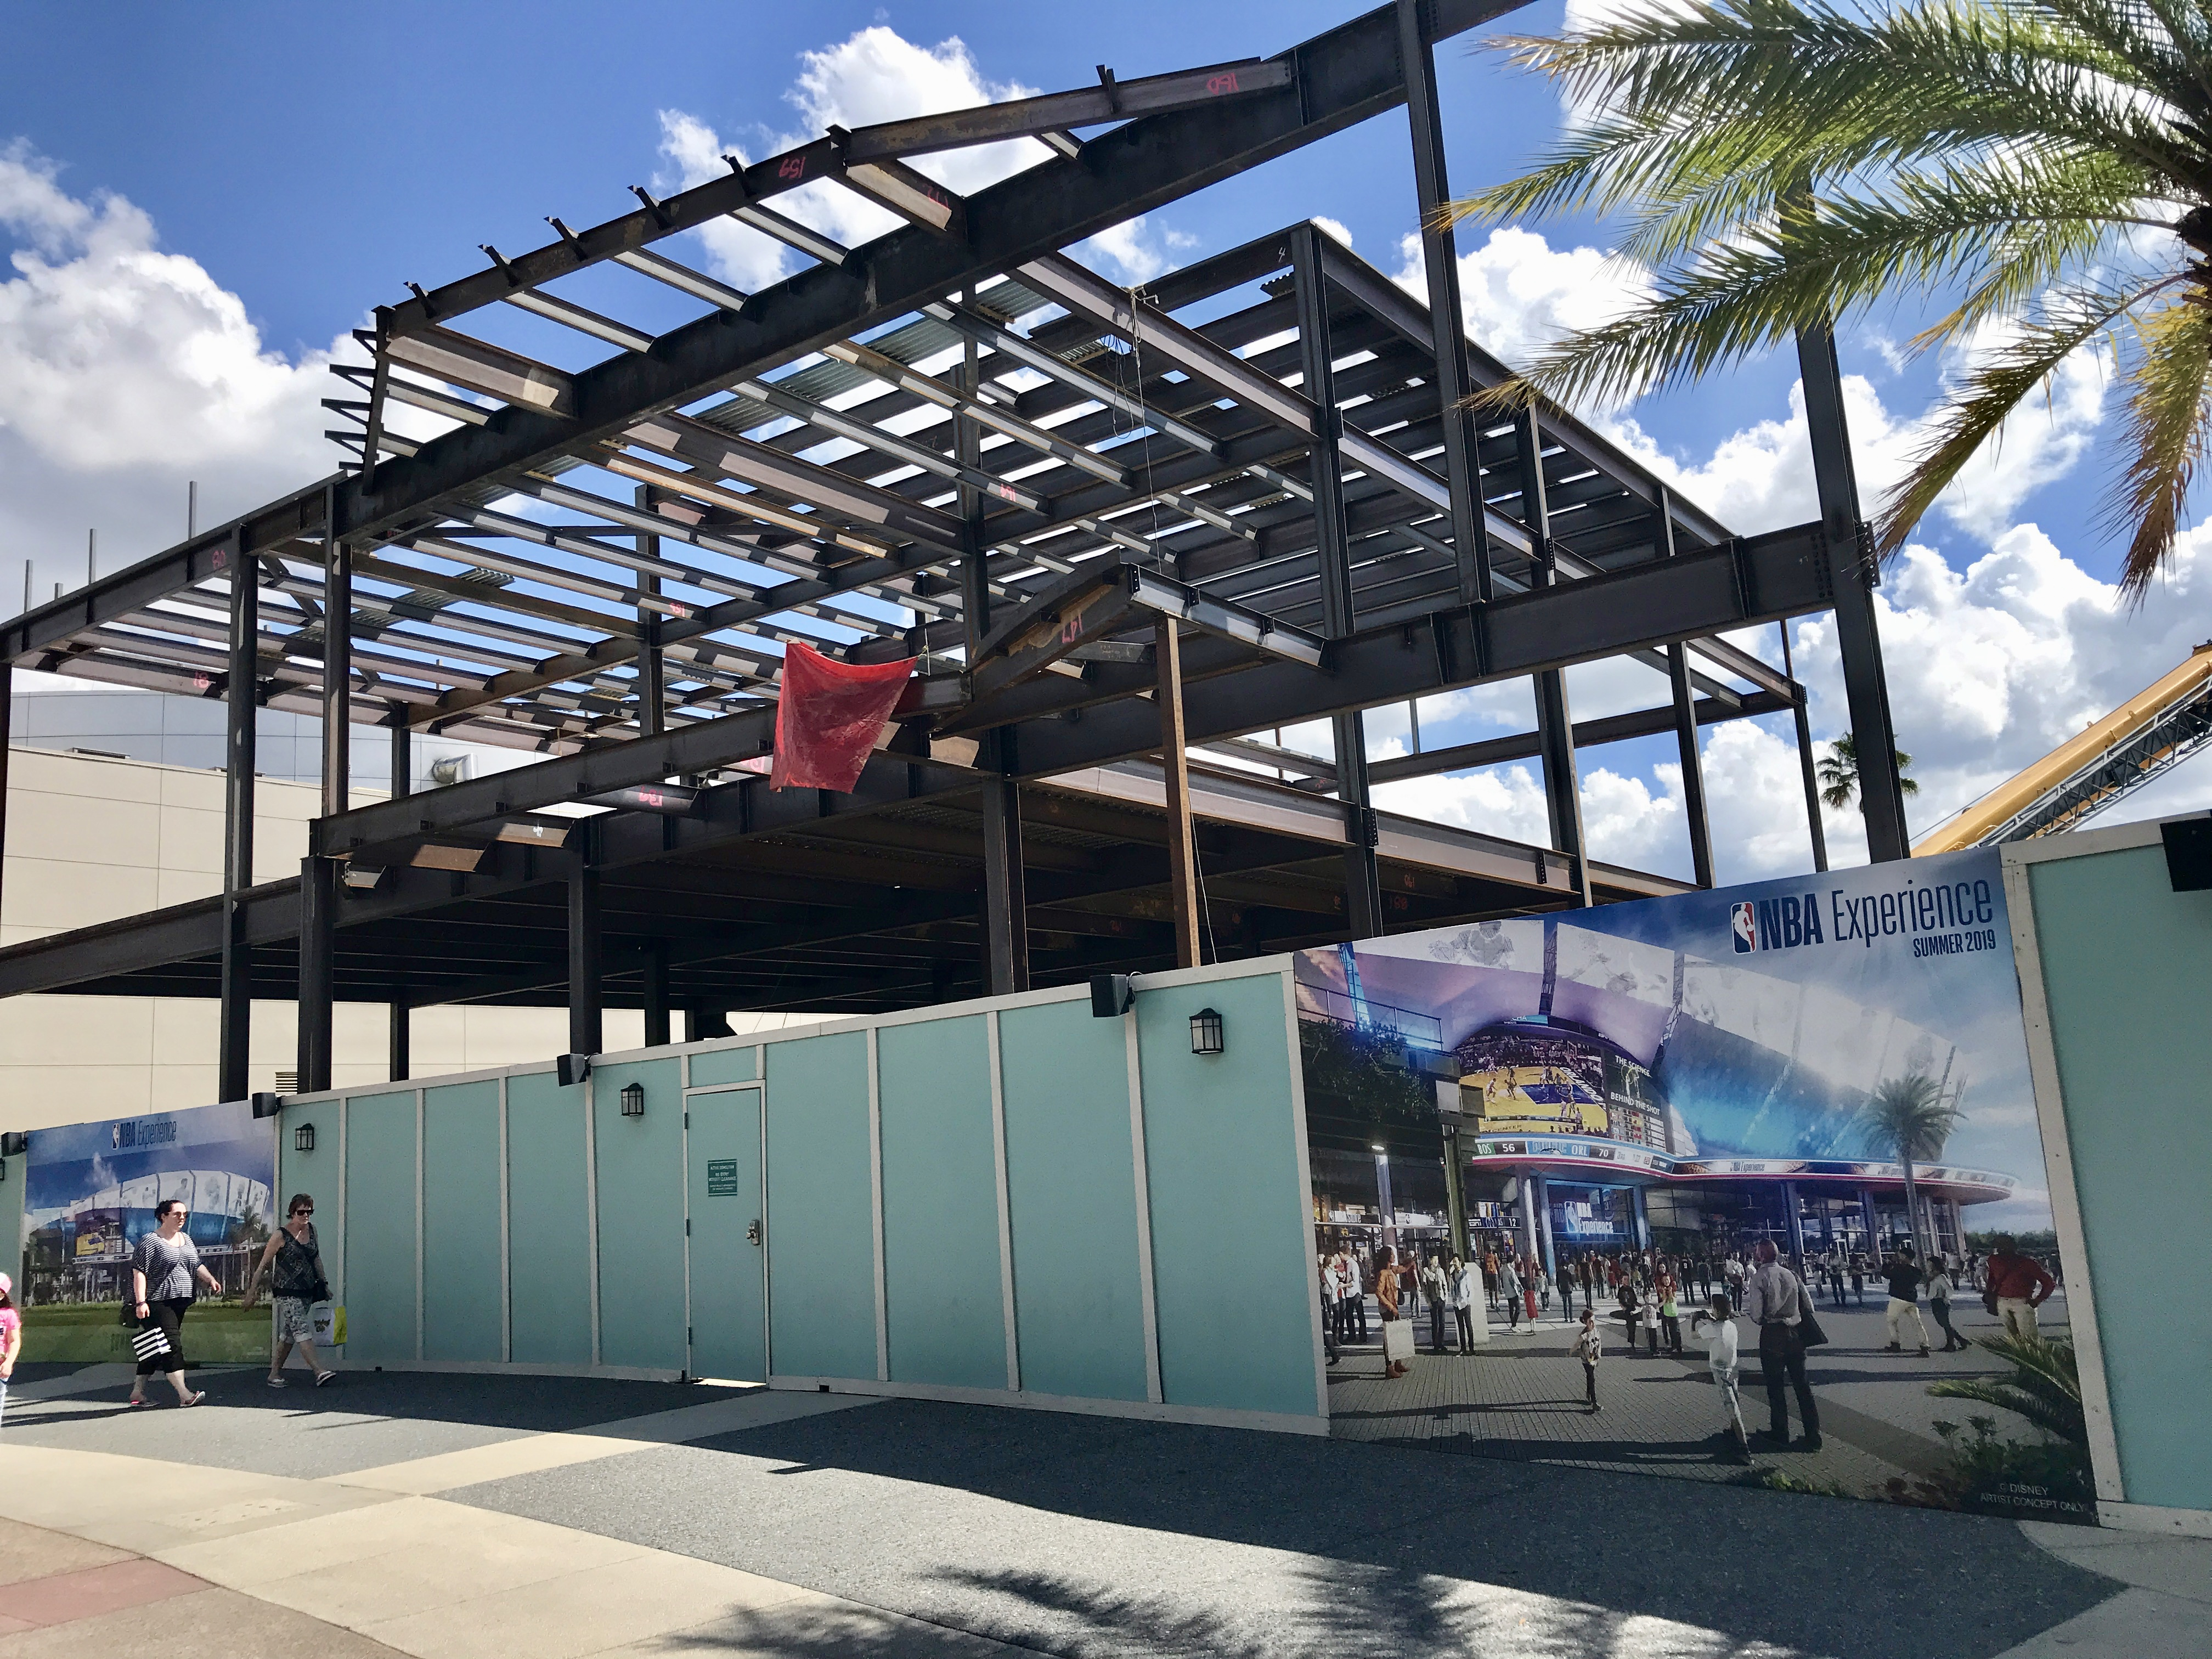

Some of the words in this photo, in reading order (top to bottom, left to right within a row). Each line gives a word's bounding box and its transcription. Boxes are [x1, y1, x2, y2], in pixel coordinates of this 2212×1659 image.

[1759, 893, 1824, 951] NBA
[1832, 879, 1993, 948] Experience
[1913, 933, 1964, 958] SUMMER
[1966, 929, 1996, 952] 2019
[1615, 1055, 1627, 1066] THE
[1611, 1092, 1634, 1106] BEHIND
[1633, 1099, 1646, 1110] THE
[1646, 1104, 1660, 1115] SHOT
[120, 1121, 136, 1148] NBA
[138, 1117, 177, 1149] Experience
[1477, 1143, 1492, 1155] BOS
[1502, 1143, 1515, 1152] 56
[1571, 1145, 1588, 1156] ORL
[1599, 1149, 1609, 1157] 70
[1579, 1217, 1614, 1235] Experience
[2010, 1483, 2049, 1496] DISNEY
[1980, 1492, 2011, 1505] ARTIST
[2013, 1497, 2057, 1509] CONCEPT
[2059, 1501, 2085, 1513] ONLY
